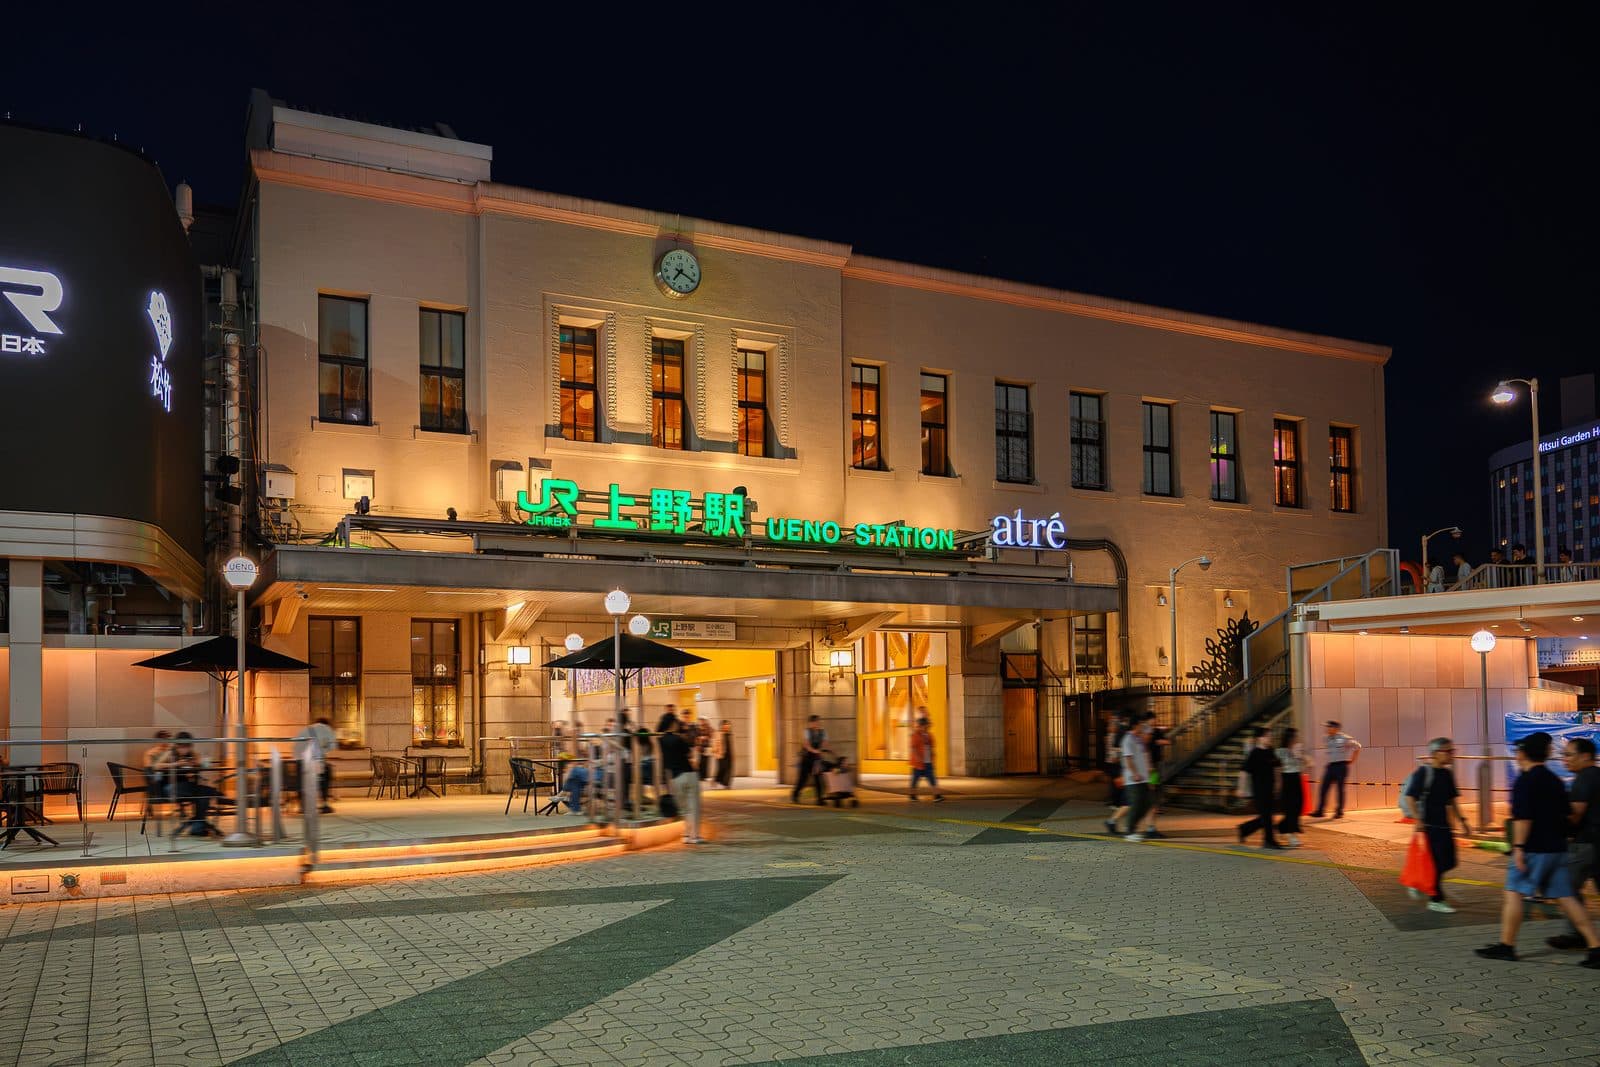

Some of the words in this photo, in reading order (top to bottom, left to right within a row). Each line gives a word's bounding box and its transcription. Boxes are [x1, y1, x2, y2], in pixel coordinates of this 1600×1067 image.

[150, 355, 171, 413] 松竹
[1560, 431, 1590, 445] Garden
[1592, 426, 1600, 437] H
[517, 479, 579, 515] JR
[593, 483, 745, 537] 上野駅
[767, 517, 840, 544] UENO
[854, 522, 954, 550] STATION
[992, 508, 1066, 549] atré
[652, 622, 669, 632] JR
